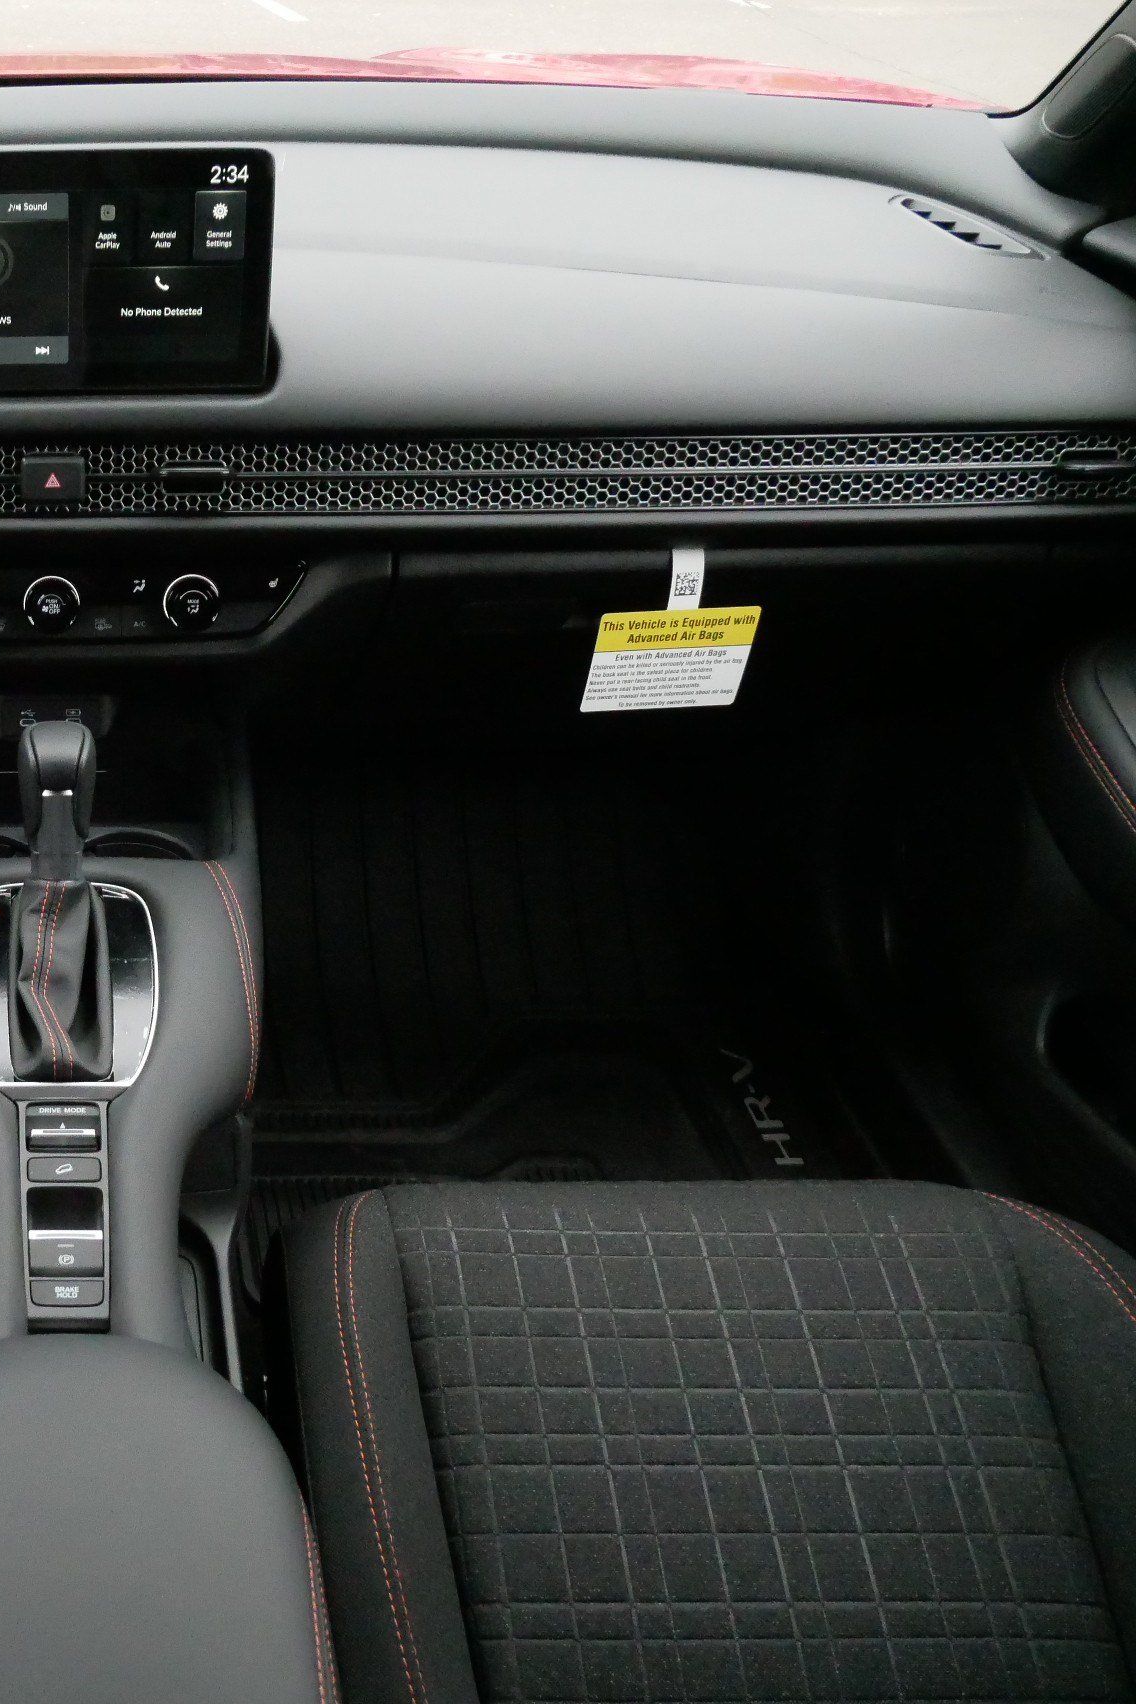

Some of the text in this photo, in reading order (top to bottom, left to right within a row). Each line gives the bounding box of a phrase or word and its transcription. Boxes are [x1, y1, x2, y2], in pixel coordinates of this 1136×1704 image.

[210, 165, 249, 184] 2:34
[23, 202, 48, 211] Sound
[98, 232, 117, 241] Apple
[150, 230, 177, 239] Android
[206, 230, 232, 239] General
[95, 241, 121, 250] CarPlay
[154, 240, 172, 248] Auto
[206, 239, 232, 248] Settings
[120, 306, 203, 317] No Phone Detected
[603, 614, 756, 631] This Vehicle is Equipped with
[627, 630, 725, 644] Advanced Air Bags
[614, 649, 728, 662] Even with Advanced Air Bags
[38, 1106, 87, 1114] DRIVE MODE
